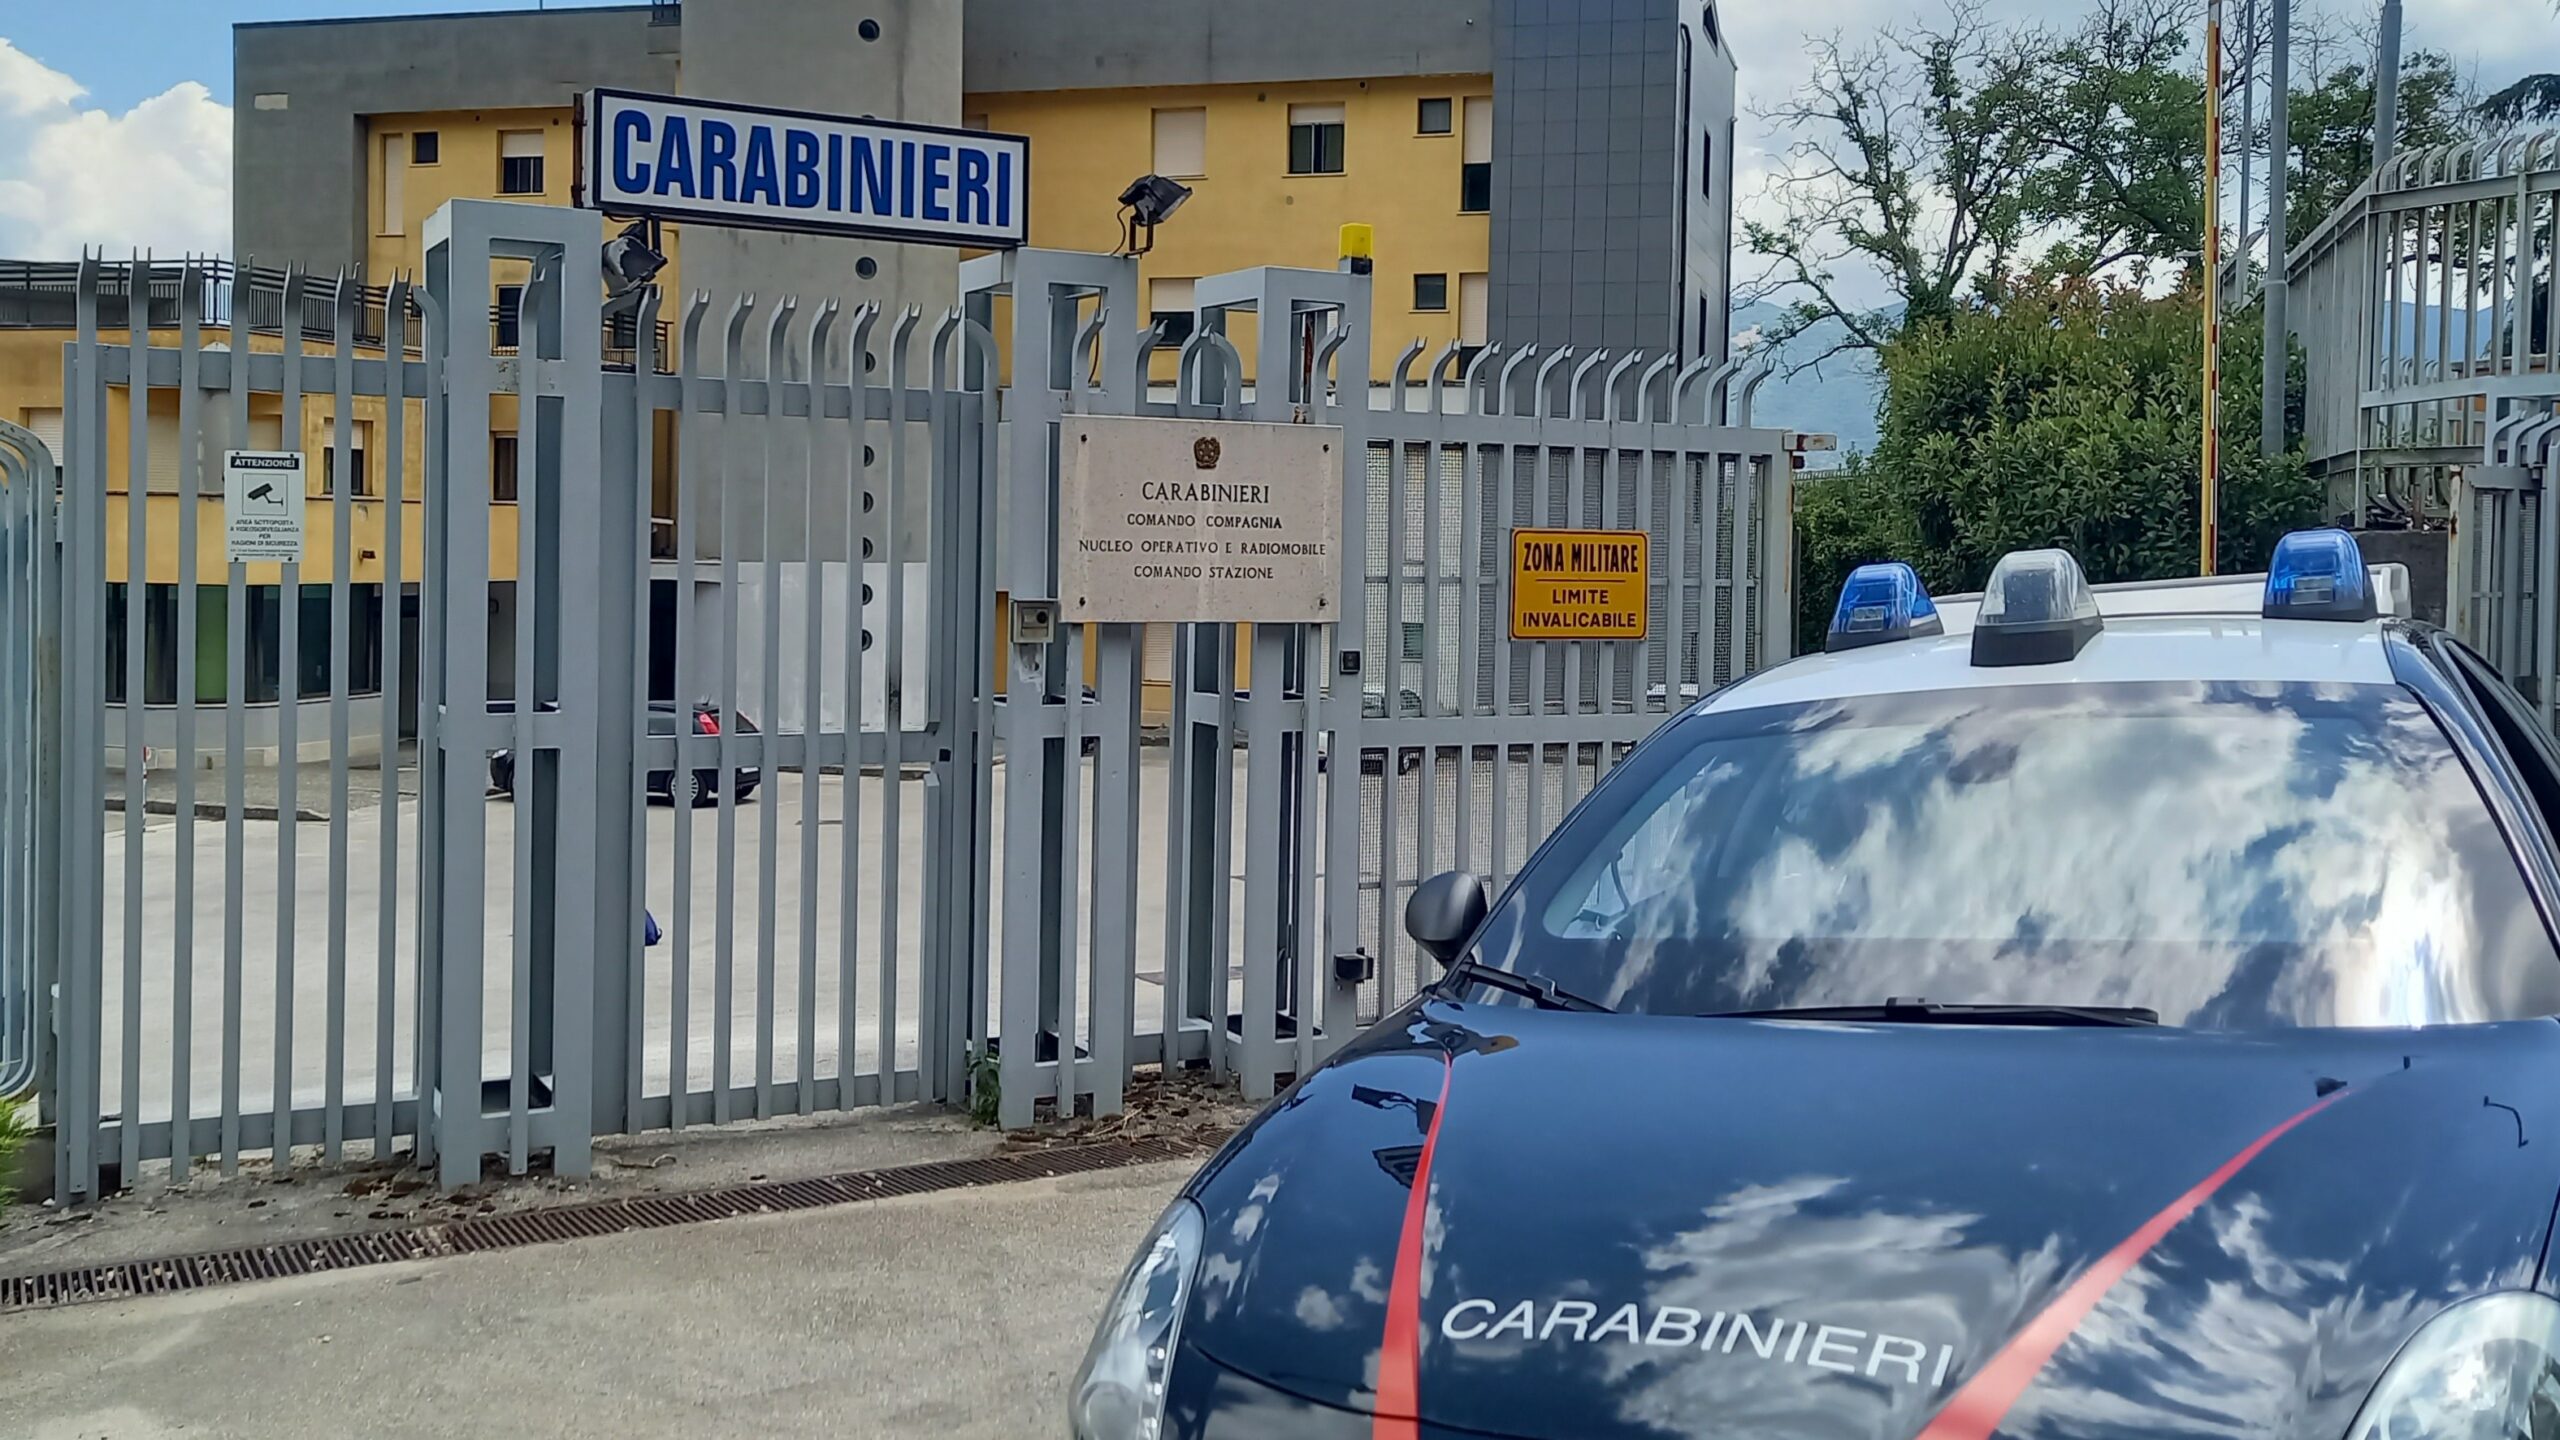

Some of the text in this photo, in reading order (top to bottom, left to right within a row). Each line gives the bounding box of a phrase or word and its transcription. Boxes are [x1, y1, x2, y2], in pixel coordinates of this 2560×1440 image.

[612, 109, 1012, 228] CARABINIERI
[234, 458, 296, 468] ATTENZIONE!
[1141, 481, 1270, 504] CARABINIERI
[1127, 513, 1283, 529] COMANDO COMPAGNIA
[1078, 540, 1326, 555] NUCLEO OPERATIVO E RADIOMOBILE
[1522, 542, 1639, 573] ZONA MILITARE
[1133, 565, 1274, 579] COMANDO STAZIONE
[1552, 589, 1609, 605] LIMITE
[1522, 612, 1637, 628] INVALICABILE
[1440, 1298, 1955, 1387] CARABINIERI
